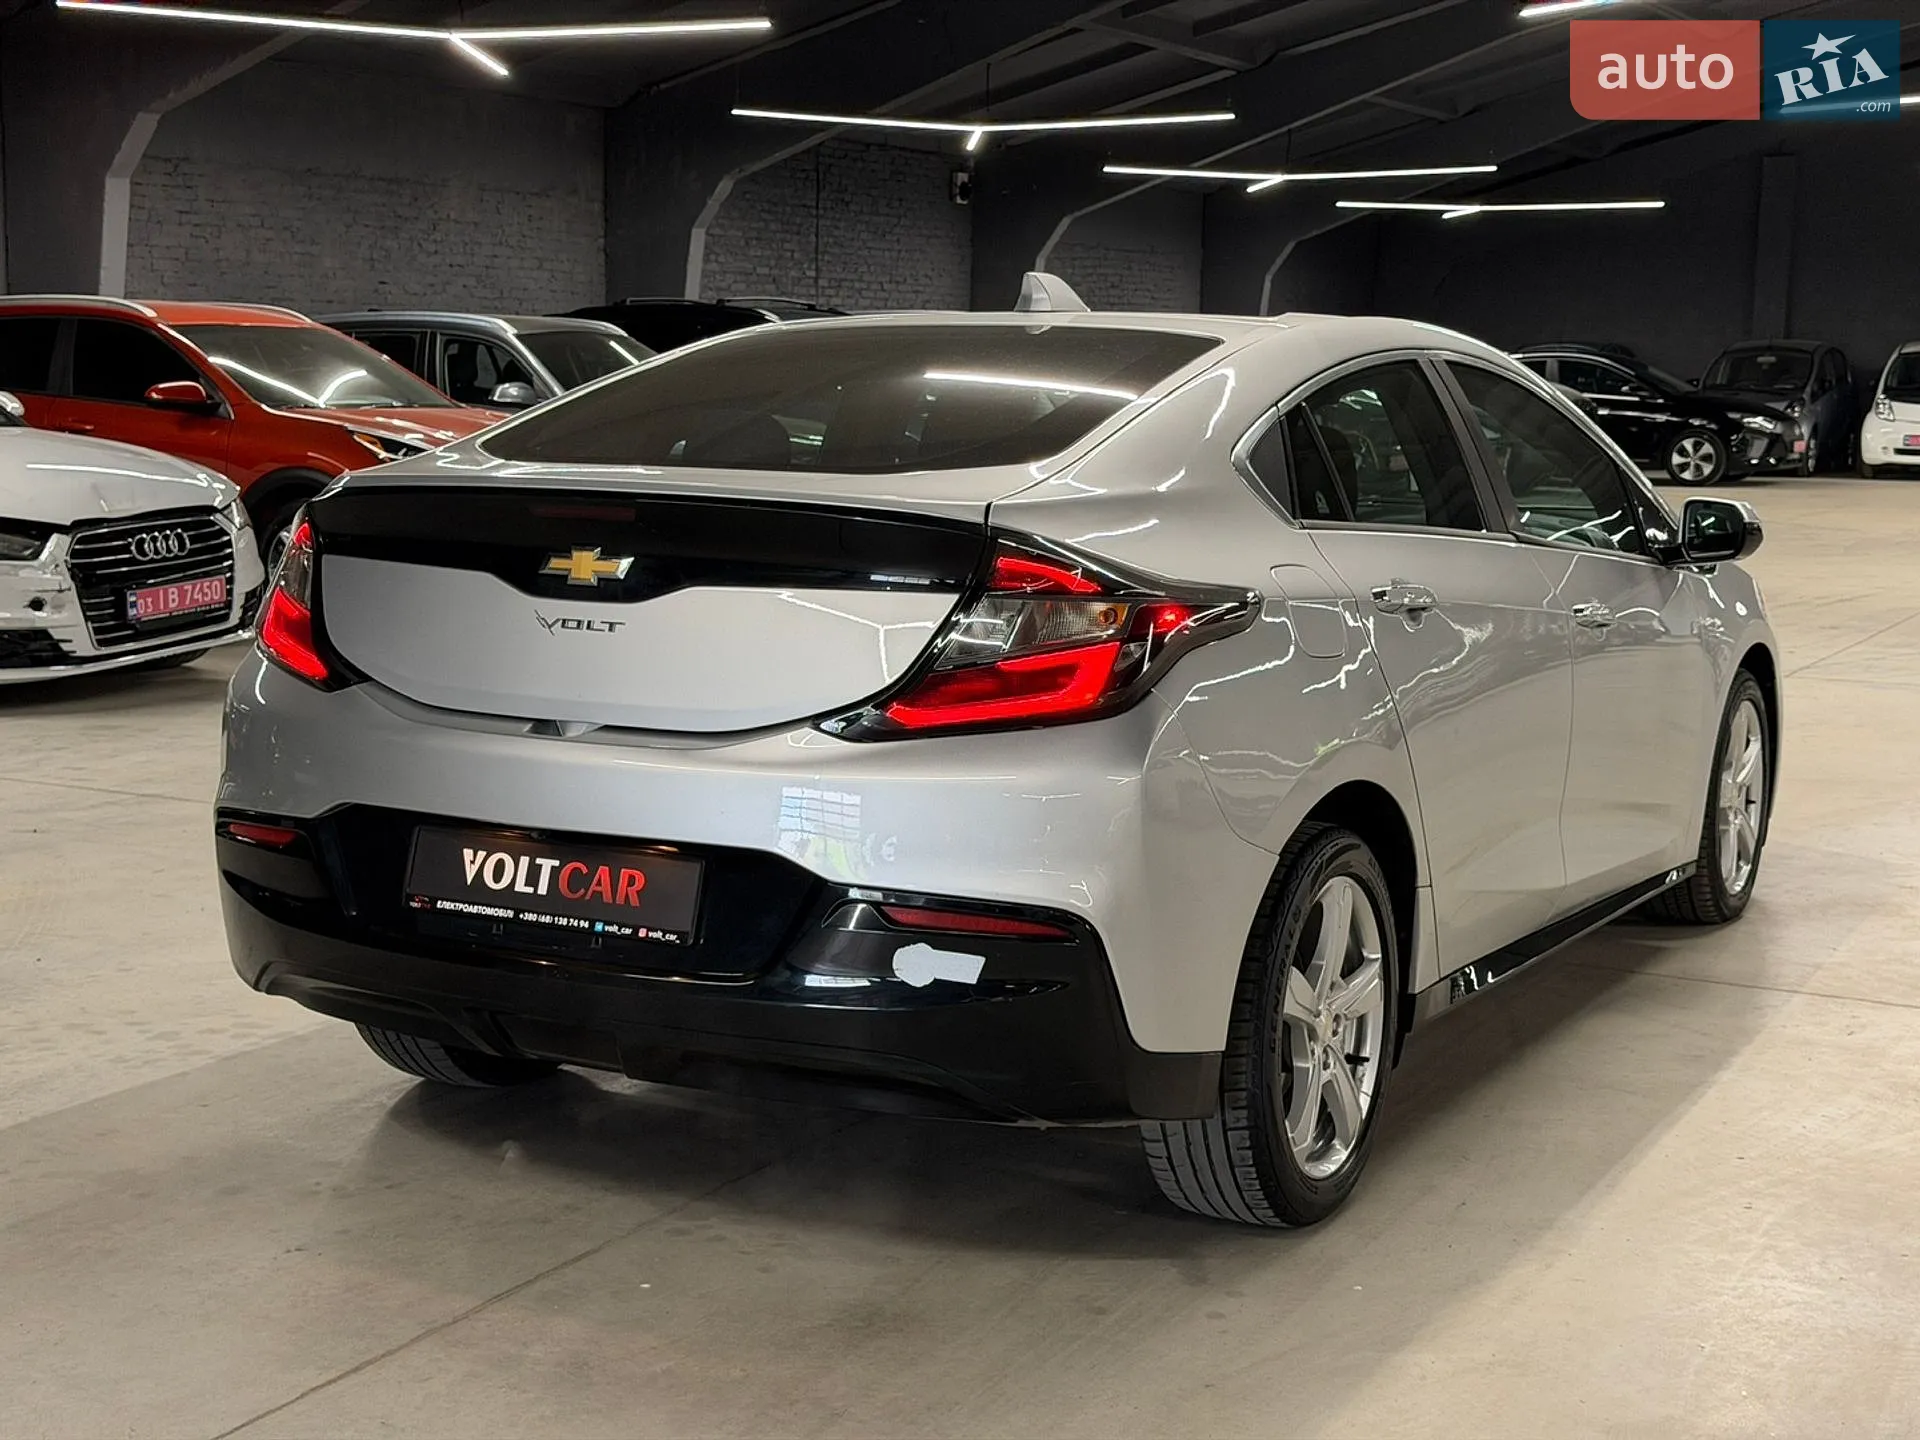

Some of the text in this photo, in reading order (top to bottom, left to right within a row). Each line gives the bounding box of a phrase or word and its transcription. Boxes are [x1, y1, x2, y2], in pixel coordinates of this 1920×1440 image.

[136, 597, 153, 614] 03
[183, 580, 221, 605] 7450
[534, 609, 626, 636] VOLT
[462, 847, 647, 908] VOLTCAR
